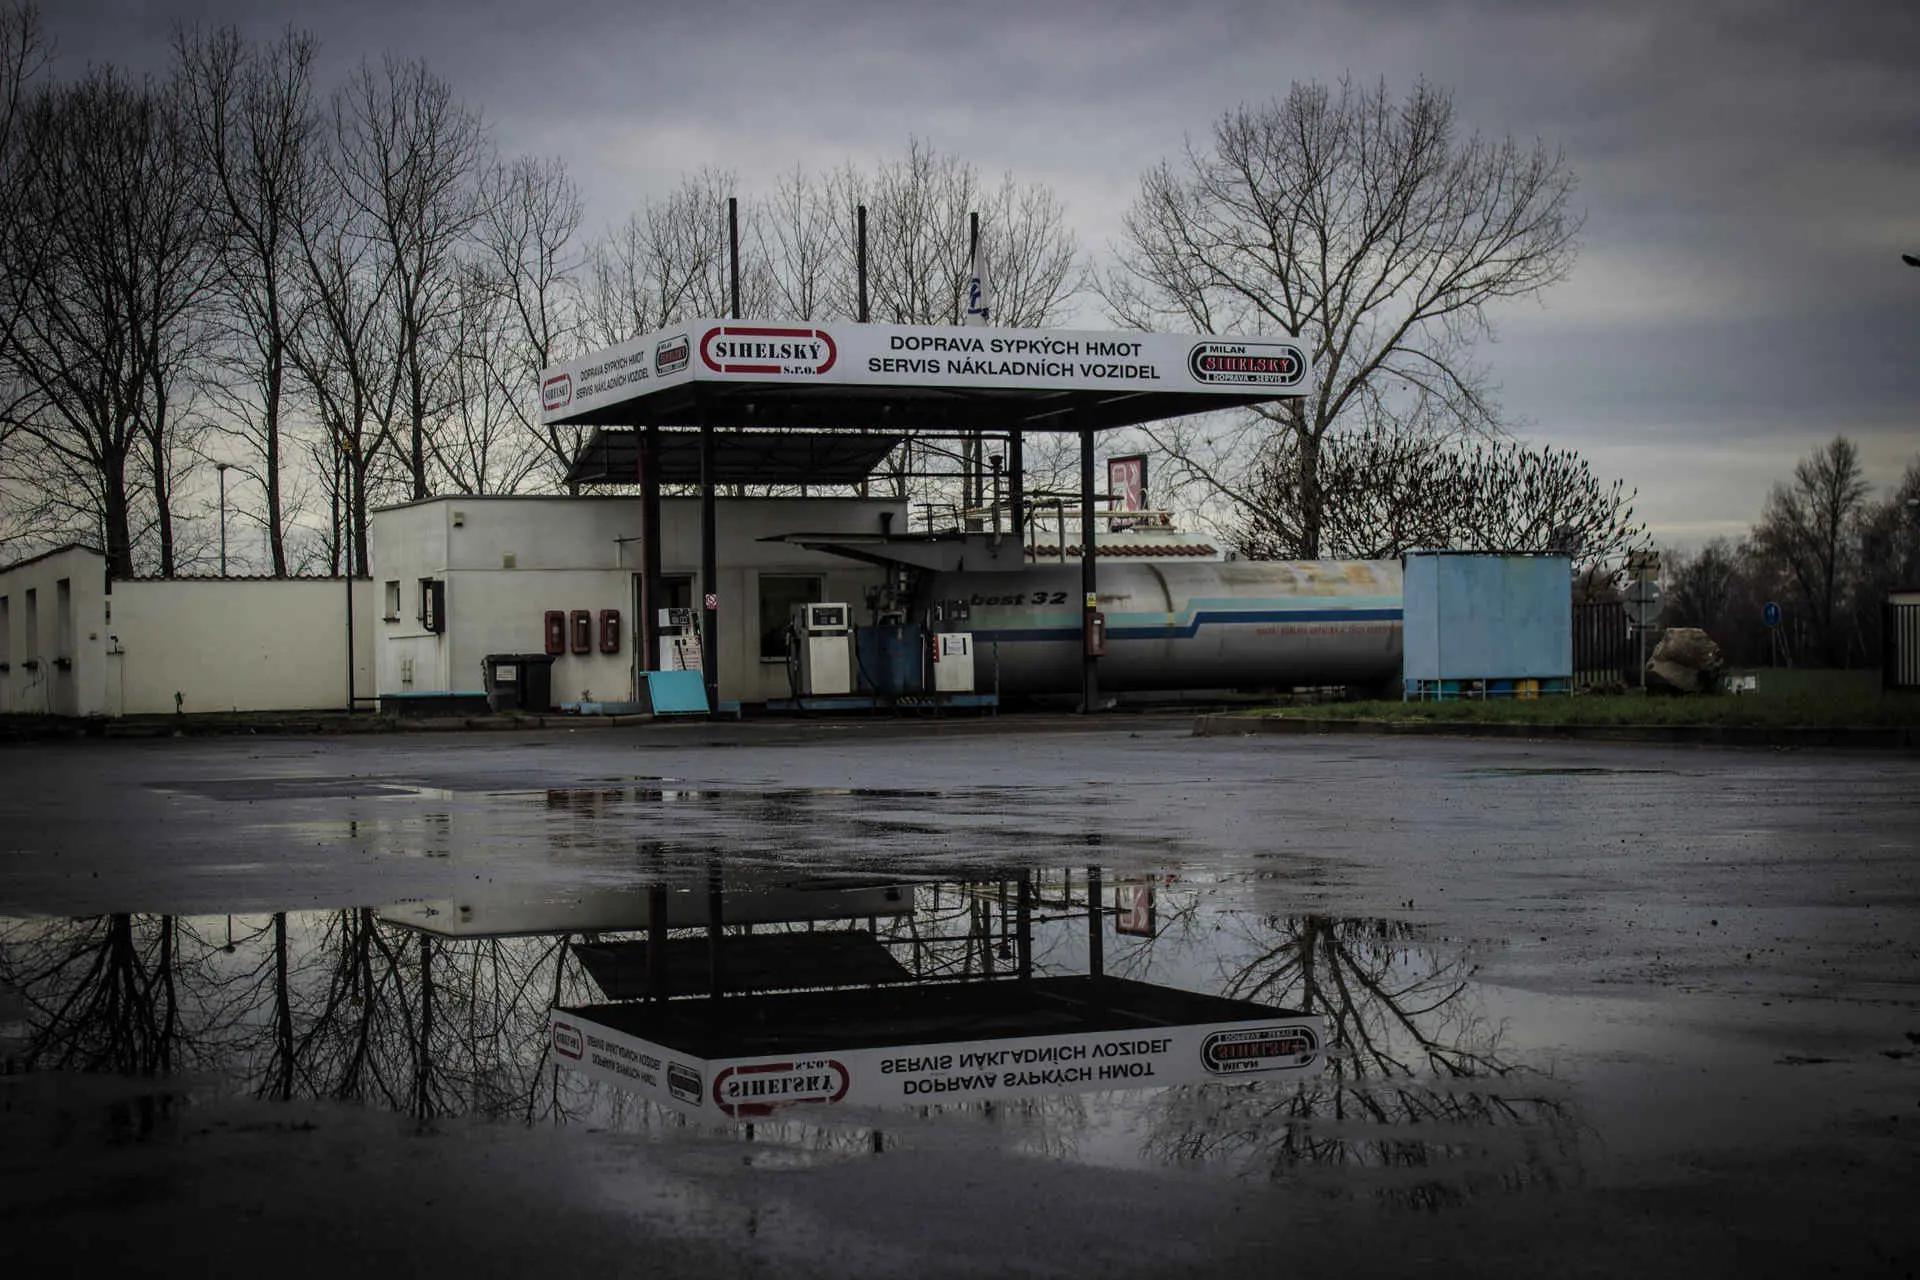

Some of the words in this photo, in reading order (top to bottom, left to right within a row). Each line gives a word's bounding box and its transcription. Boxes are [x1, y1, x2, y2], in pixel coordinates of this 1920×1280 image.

[716, 341, 821, 360] SIHELSKÝ
[890, 336, 984, 353] DOPRAVA
[990, 336, 1079, 355] SYPKÝCH
[1086, 342, 1142, 357] HMOT
[1209, 346, 1246, 354] MILAN
[783, 366, 816, 375] s.r.o.
[868, 358, 940, 374] SERVIS
[947, 356, 1074, 377] NÁKLADNÍCH
[1080, 364, 1160, 380] VOZIDEL
[1031, 591, 1068, 605] 32
